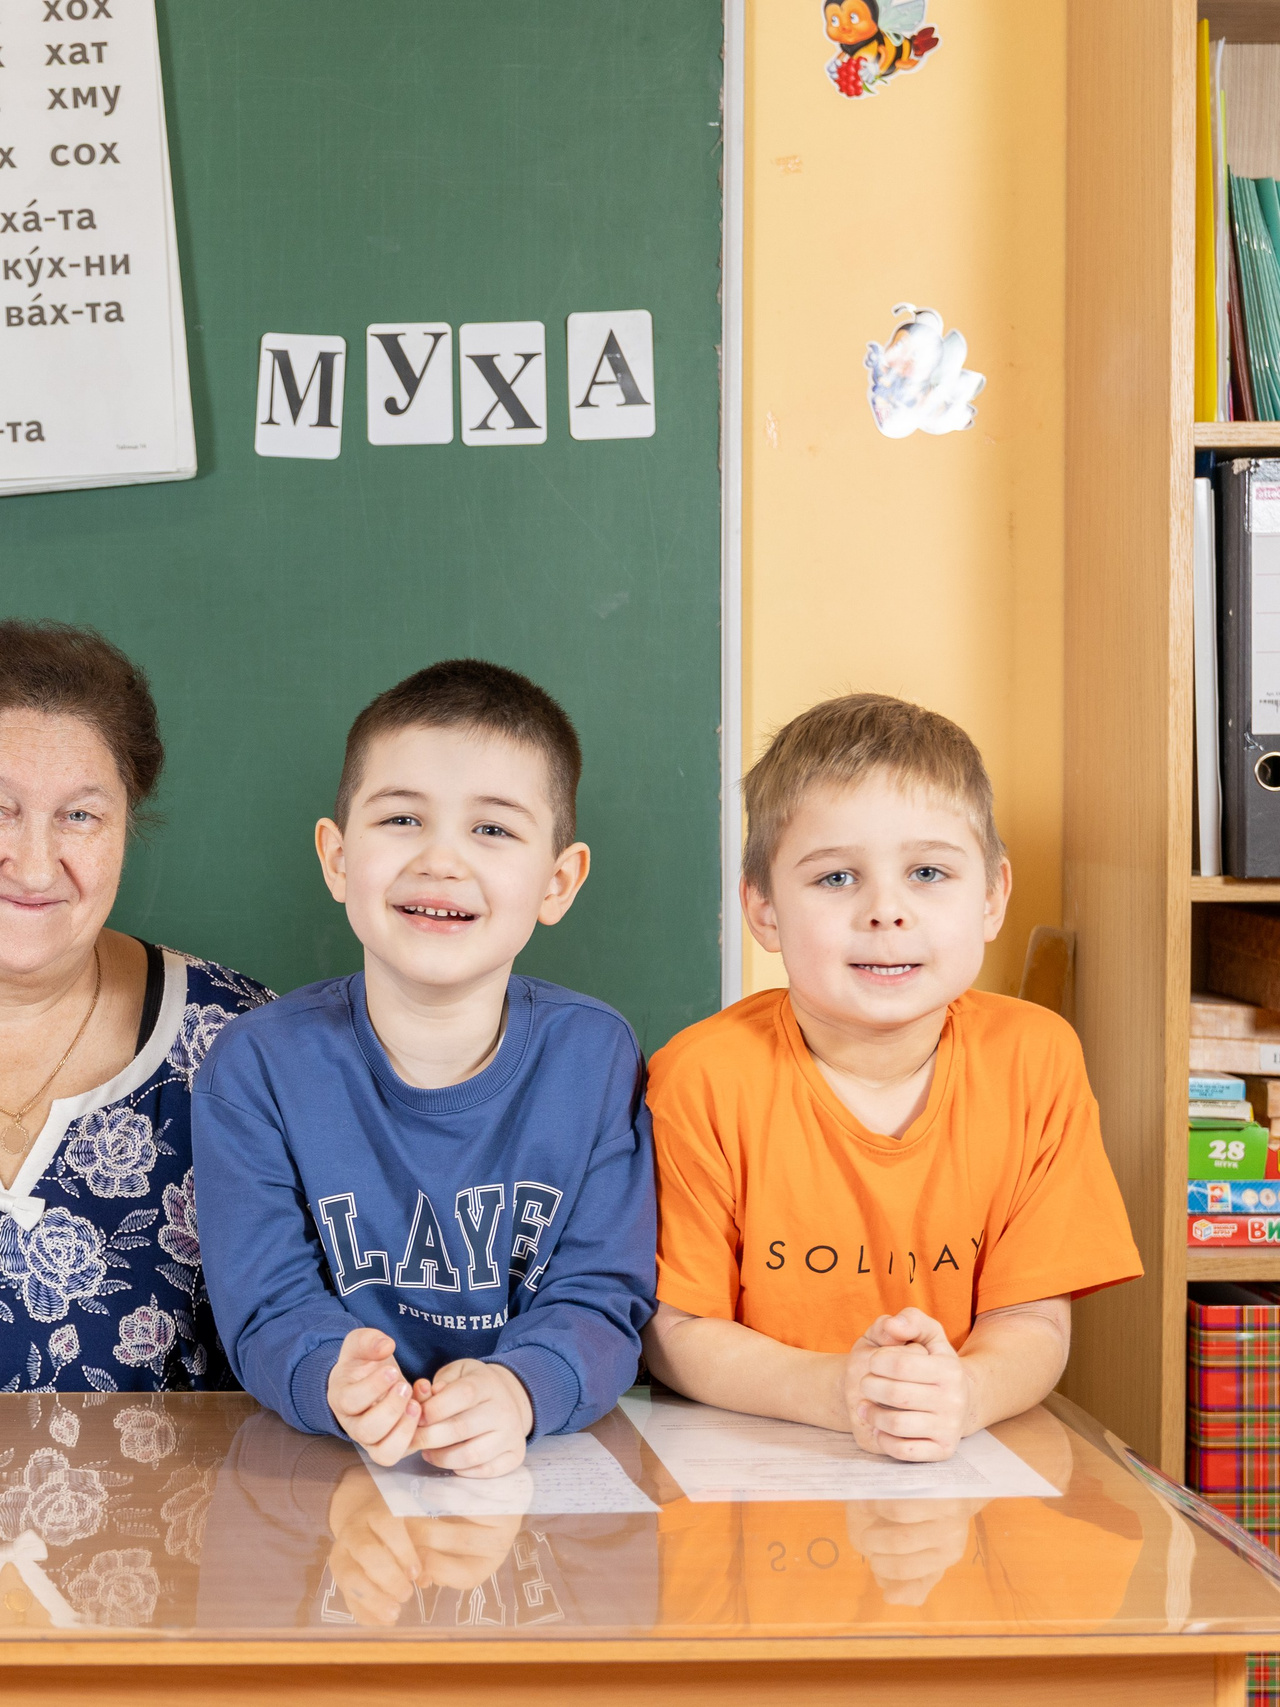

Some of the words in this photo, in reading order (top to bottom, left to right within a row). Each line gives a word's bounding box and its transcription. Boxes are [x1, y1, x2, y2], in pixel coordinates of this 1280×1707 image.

[44, 0, 112, 21] хох
[46, 42, 107, 65] хат
[49, 86, 120, 116] хму
[51, 143, 119, 166] сох
[1208, 1139, 1246, 1162] 28
